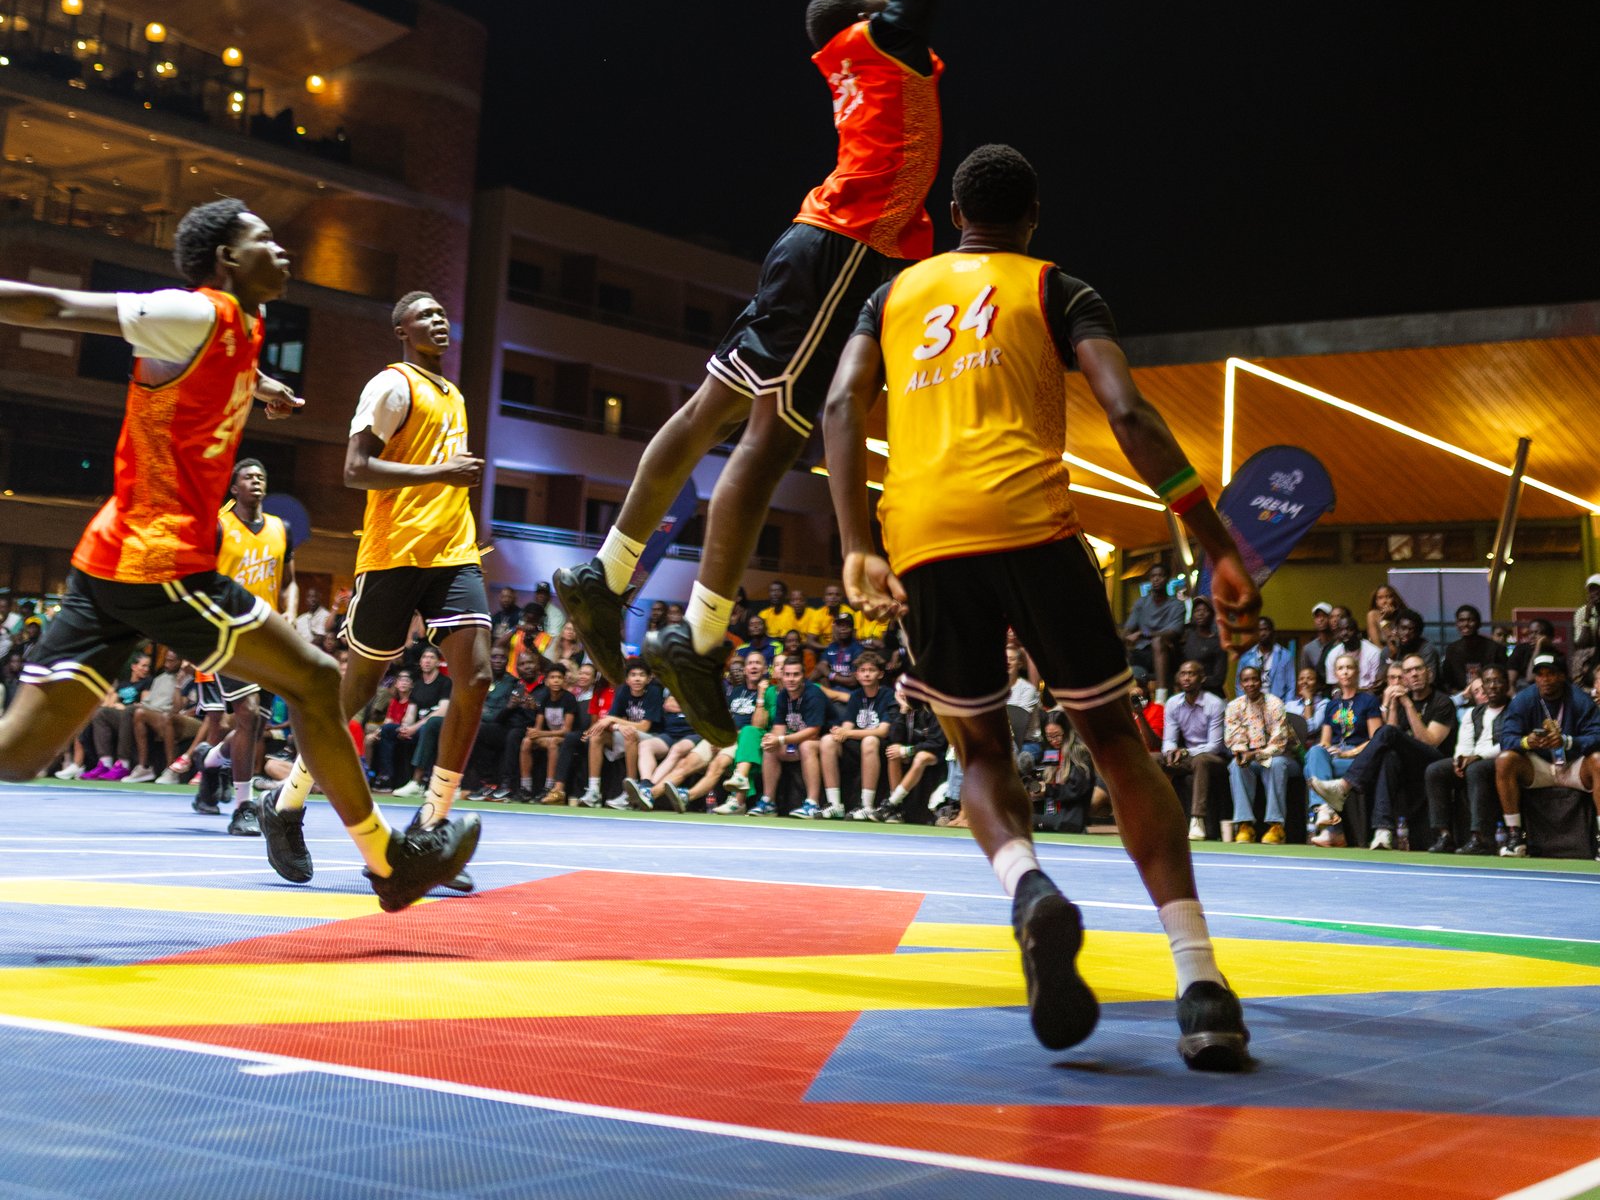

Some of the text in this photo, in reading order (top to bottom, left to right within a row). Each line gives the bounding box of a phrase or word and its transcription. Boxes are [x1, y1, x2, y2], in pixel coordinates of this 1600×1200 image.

[913, 285, 998, 361] 34
[904, 347, 1003, 395] ALL STAR
[1250, 495, 1304, 520] DREAM
[237, 544, 275, 571] ALL
[233, 558, 277, 587] STAR
